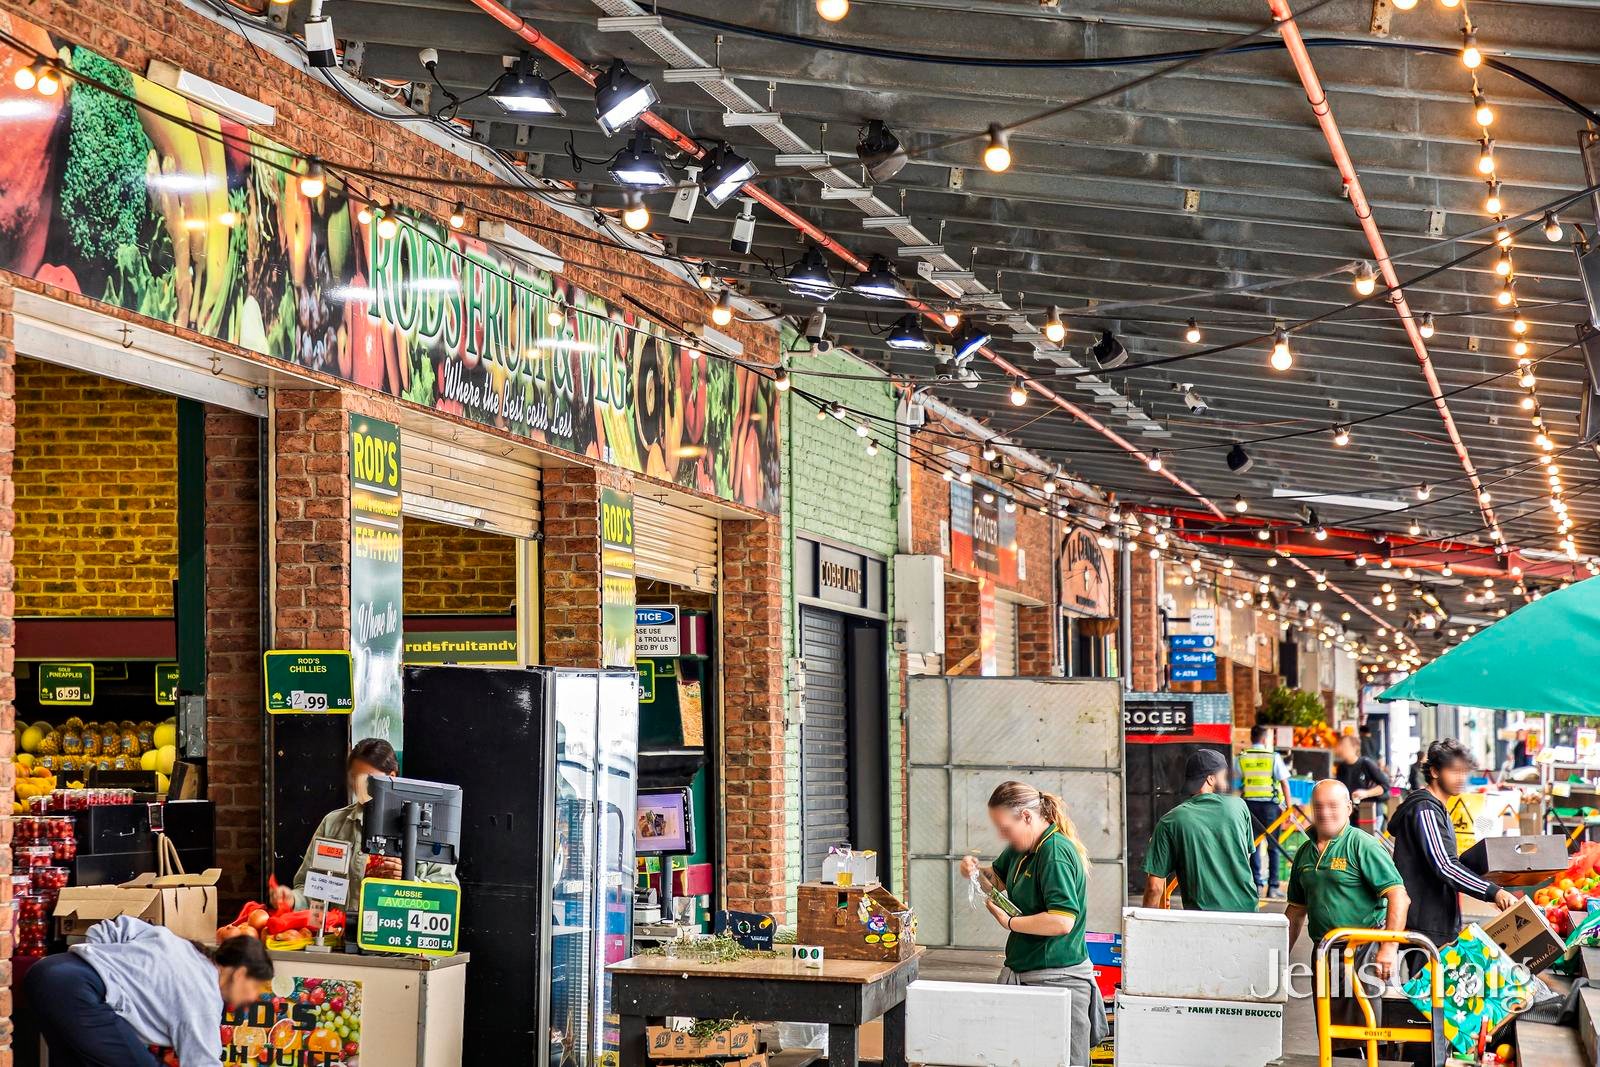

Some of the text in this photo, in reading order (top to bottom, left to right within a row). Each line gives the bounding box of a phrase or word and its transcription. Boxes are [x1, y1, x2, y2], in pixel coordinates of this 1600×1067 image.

[575, 303, 627, 410] VEG
[444, 358, 573, 438] Where the Best costs Less
[353, 431, 398, 487] ROD'S
[603, 502, 632, 545] ROD'S
[821, 560, 862, 594] COBB LANE
[358, 601, 398, 643] Where the
[405, 640, 517, 652] rodsfruitandv
[49, 671, 83, 679] PINEAPPLES
[289, 665, 327, 673] CHILLIES
[57, 689, 79, 698] 6.99
[337, 698, 352, 706] BAG
[1124, 711, 1187, 724] ROCER
[394, 889, 423, 899] AUSSIE
[384, 897, 431, 909] AVOCADO
[410, 913, 449, 931] 4.00
[388, 936, 401, 945] OR
[405, 935, 412, 946] $
[419, 938, 440, 948] 3.00
[441, 940, 453, 949] EA
[1215, 1007, 1243, 1016] FRESH
